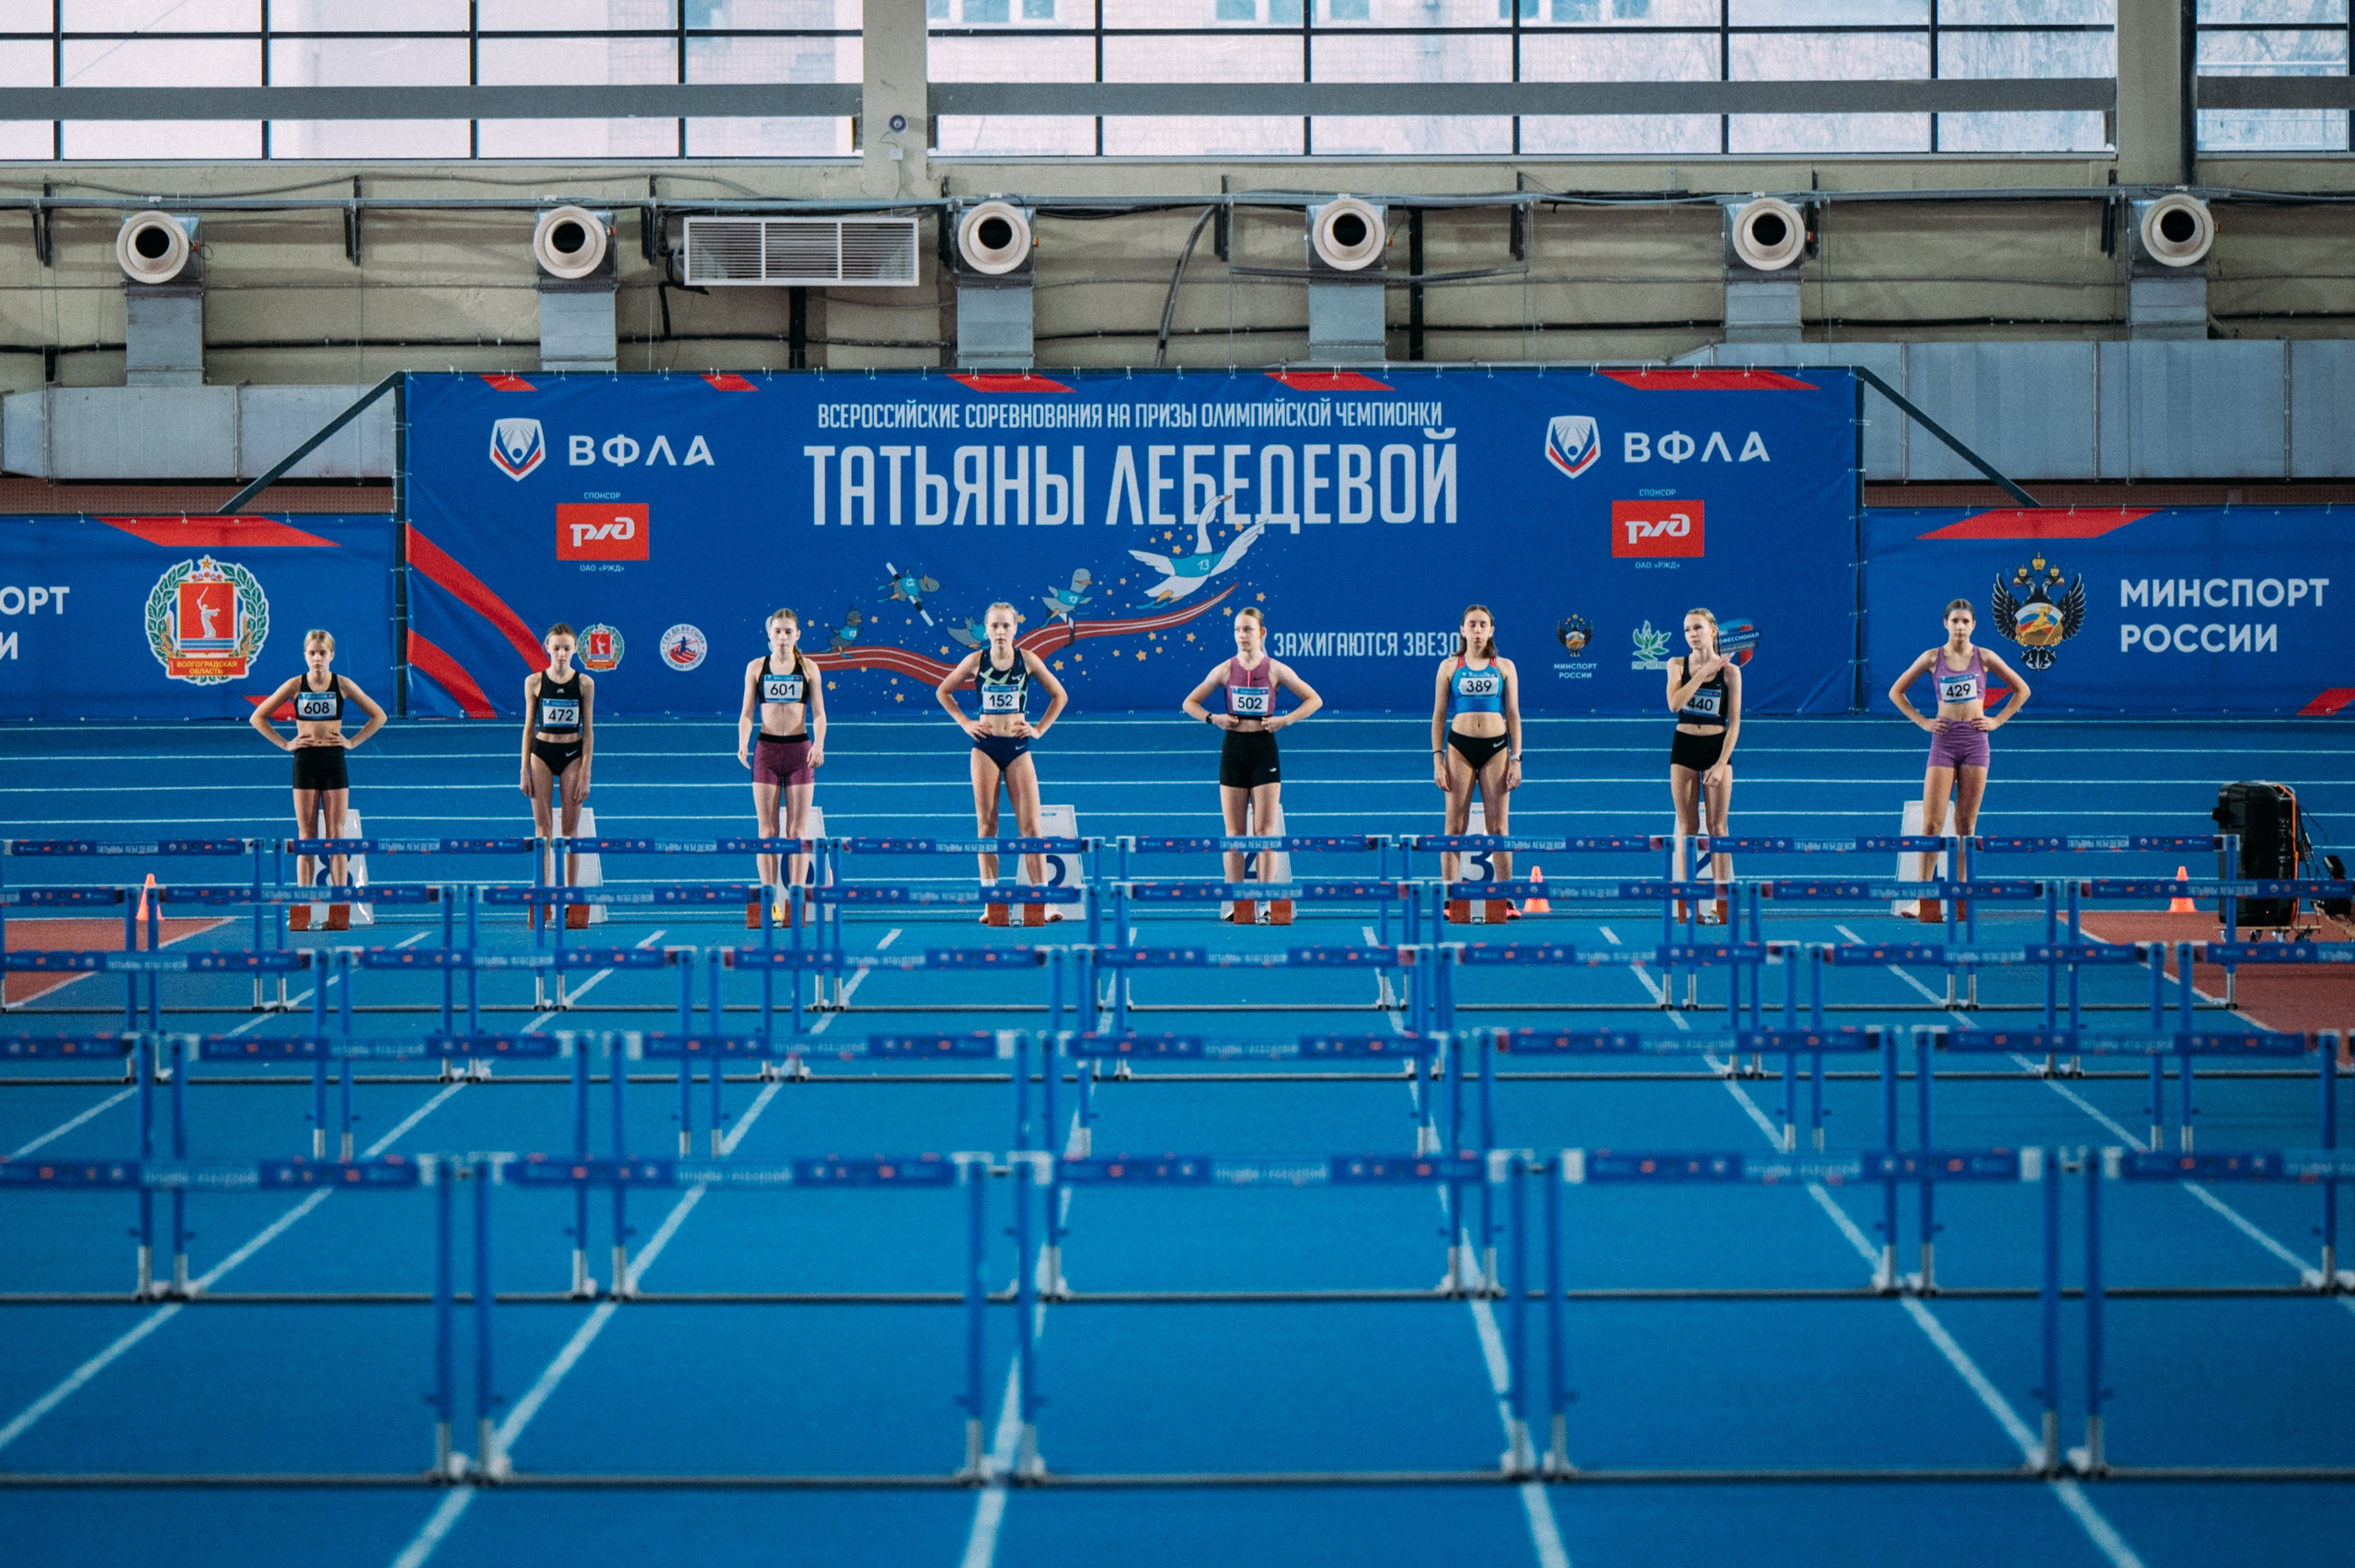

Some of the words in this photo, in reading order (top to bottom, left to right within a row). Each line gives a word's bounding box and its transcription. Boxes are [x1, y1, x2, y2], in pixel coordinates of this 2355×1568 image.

[818, 399, 960, 429] ВСЕРОССИЙСКИЕ
[965, 403, 1103, 429] СОРЕВНОВАНИЯ
[1107, 403, 1131, 428] НА
[1135, 403, 1197, 428] ПРИЗЫ
[1201, 397, 1331, 428] ОЛИМПИЙСКОЙ
[1336, 401, 1442, 427] ЧЕМПИОНКИ
[569, 433, 715, 467] ВФЛА
[1624, 430, 1771, 464] ВФЛА
[803, 445, 1085, 526] ТАТЬЯНЫ
[1105, 427, 1457, 534] ЛЕБЕДЕВОЙ
[583, 491, 621, 499] СПОНСОР
[1638, 488, 1677, 497] СПОНСОР
[580, 564, 596, 572] ОАО
[598, 564, 625, 572] «РЖД»
[1197, 559, 1210, 571] 13
[1635, 561, 1652, 569] ОАО
[1654, 561, 1681, 570] «РЖД»
[2120, 578, 2330, 608] МИНСПОРТ
[1273, 632, 1398, 657] ЗАЖИГАЮТСЯ
[1403, 632, 1462, 658] ЗВЕЗД
[1718, 632, 1760, 645] ОФЕССИОНАЛ
[2120, 624, 2278, 653] РОССИИ
[770, 683, 795, 696] 601
[1465, 680, 1491, 693] 389
[1946, 683, 1971, 698] 429
[989, 693, 1014, 707] 152
[1237, 696, 1262, 710] 502
[1687, 697, 1714, 712] 440
[304, 701, 330, 715] 608
[547, 702, 574, 716] 472
